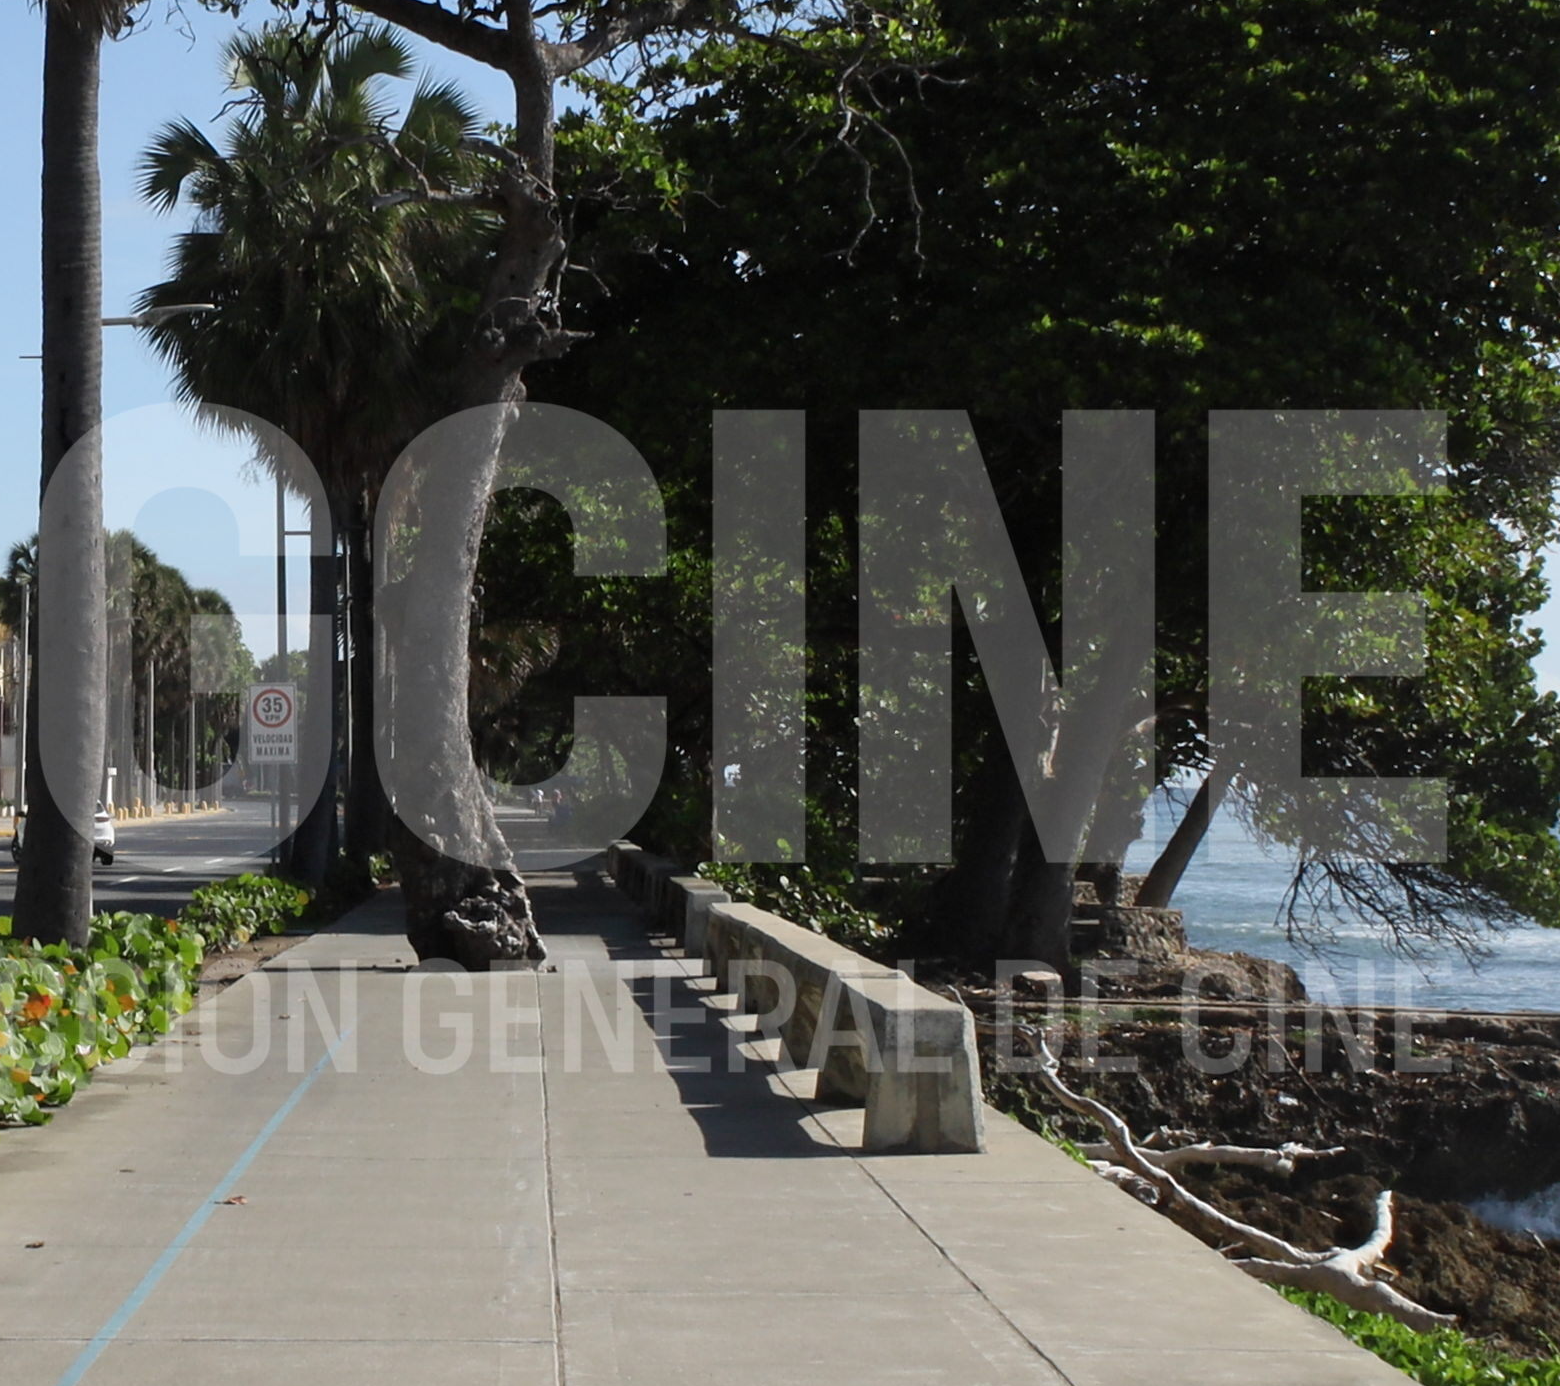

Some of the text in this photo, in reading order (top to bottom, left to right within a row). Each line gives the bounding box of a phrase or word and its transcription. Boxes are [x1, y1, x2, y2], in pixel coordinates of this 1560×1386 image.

[262, 697, 283, 713] 35
[253, 734, 293, 744] VELOCIDAD
[256, 746, 290, 756] MAXIMA
